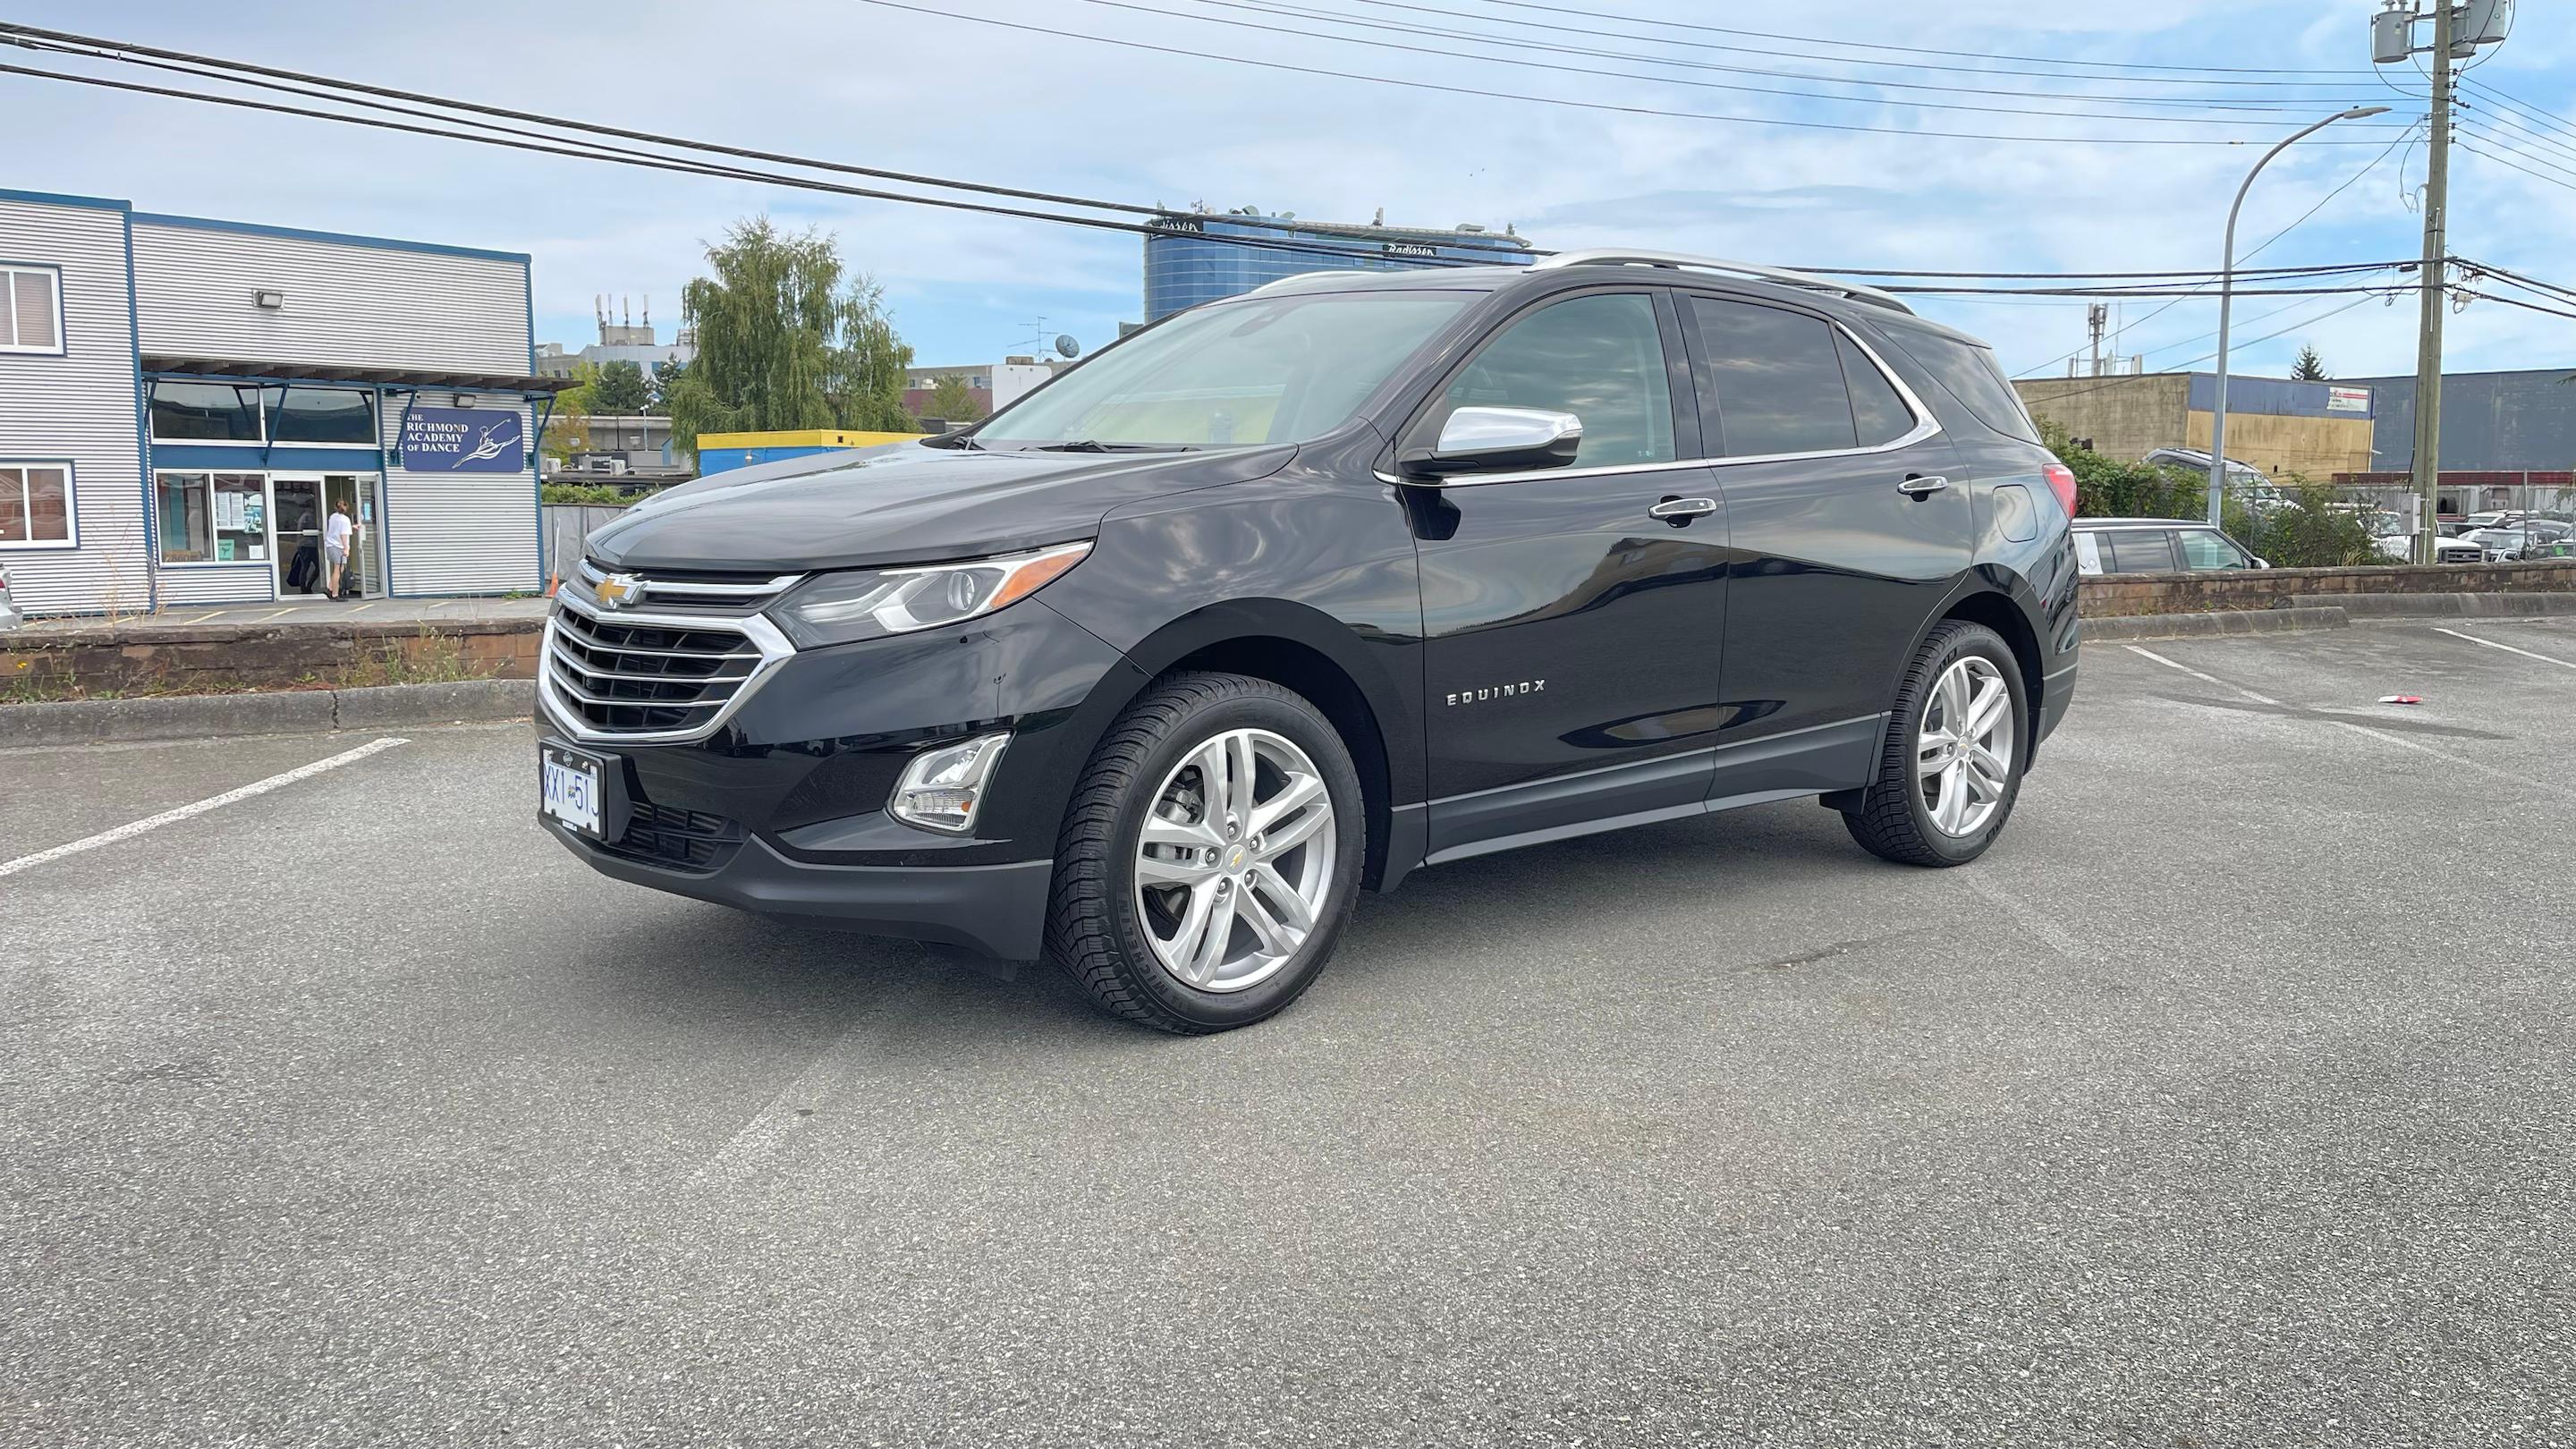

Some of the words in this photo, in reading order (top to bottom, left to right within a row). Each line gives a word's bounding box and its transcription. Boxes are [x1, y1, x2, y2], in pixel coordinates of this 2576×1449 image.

[1148, 219, 1199, 233] disson
[407, 421, 469, 433] RICHMOND
[407, 432, 463, 443] ACADEMY
[407, 444, 419, 452] OF
[421, 443, 460, 453] DANCE
[1446, 679, 1546, 707] EQUINOX
[1117, 899, 1170, 996] MICHELIN
